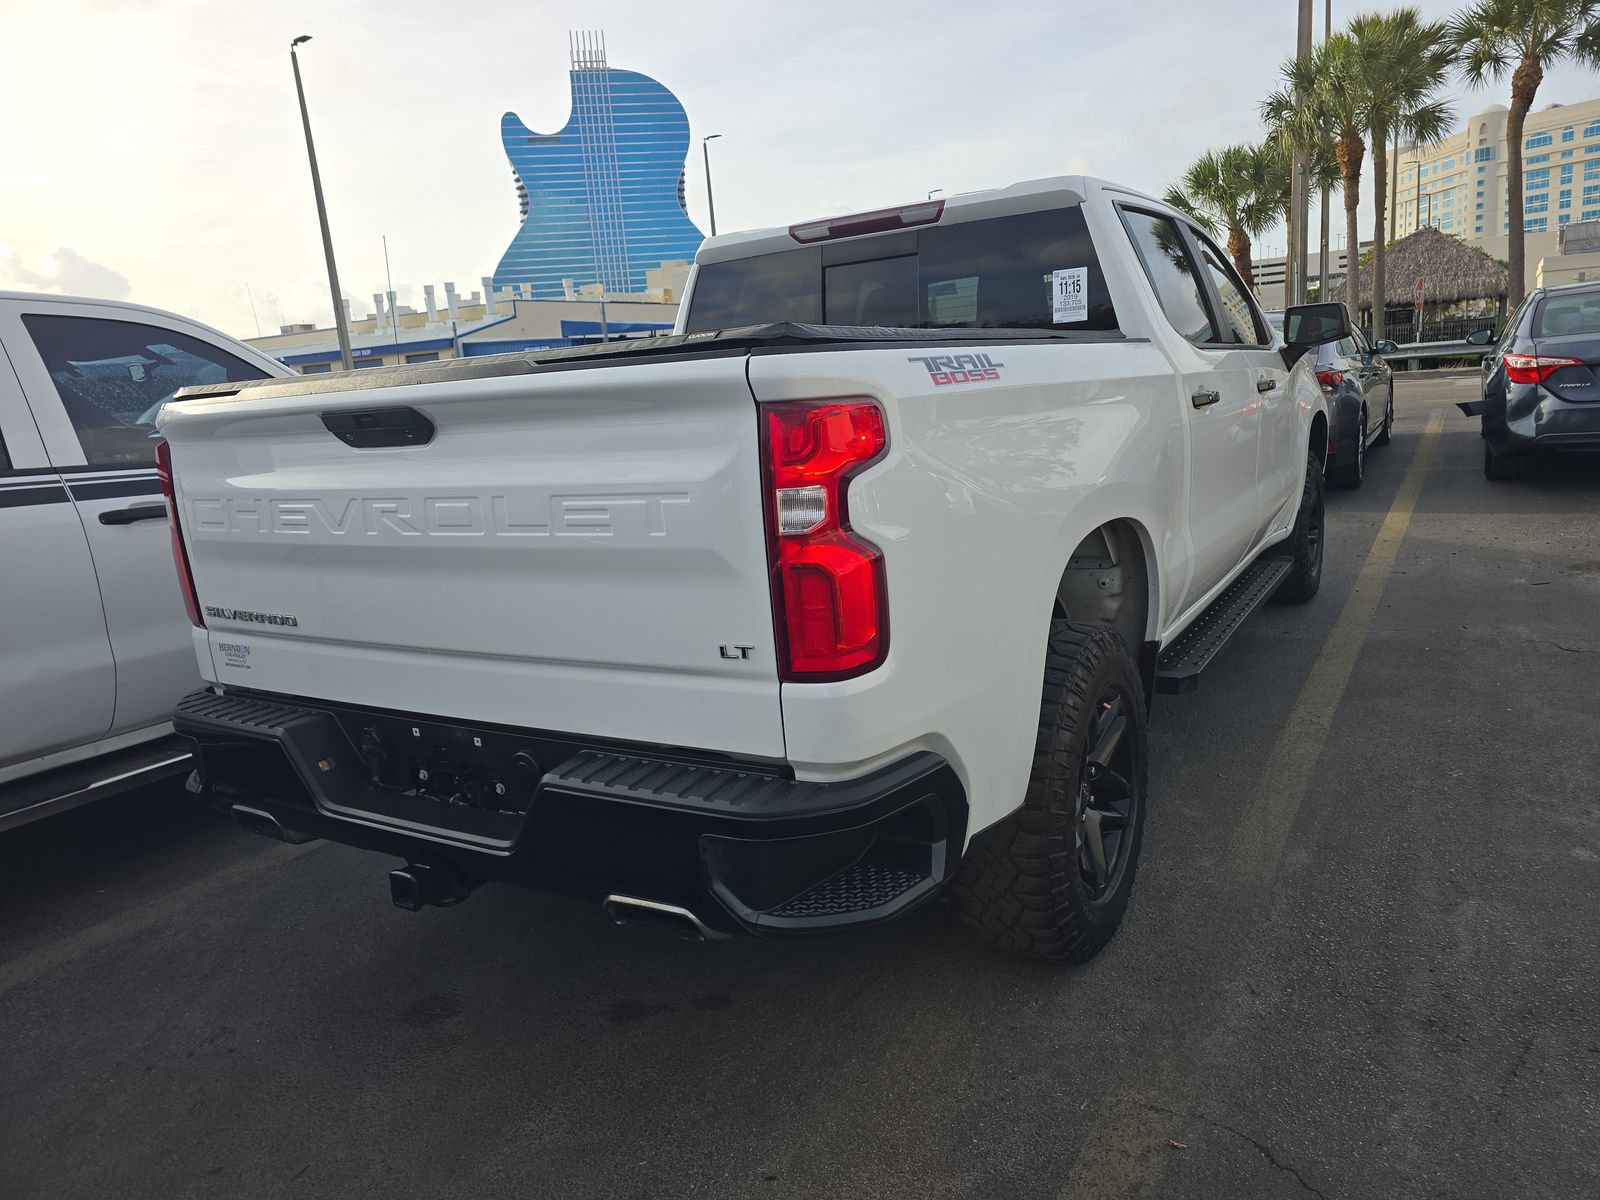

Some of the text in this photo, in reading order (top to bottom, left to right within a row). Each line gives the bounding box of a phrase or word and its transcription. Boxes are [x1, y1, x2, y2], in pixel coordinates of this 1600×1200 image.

[1059, 279, 1081, 295] 11:15
[907, 353, 1005, 372] TRAIL
[930, 368, 1001, 386] BOSS
[192, 492, 690, 536] CHEVROLET
[205, 606, 298, 627] SILVERADO
[719, 643, 755, 660] LT
